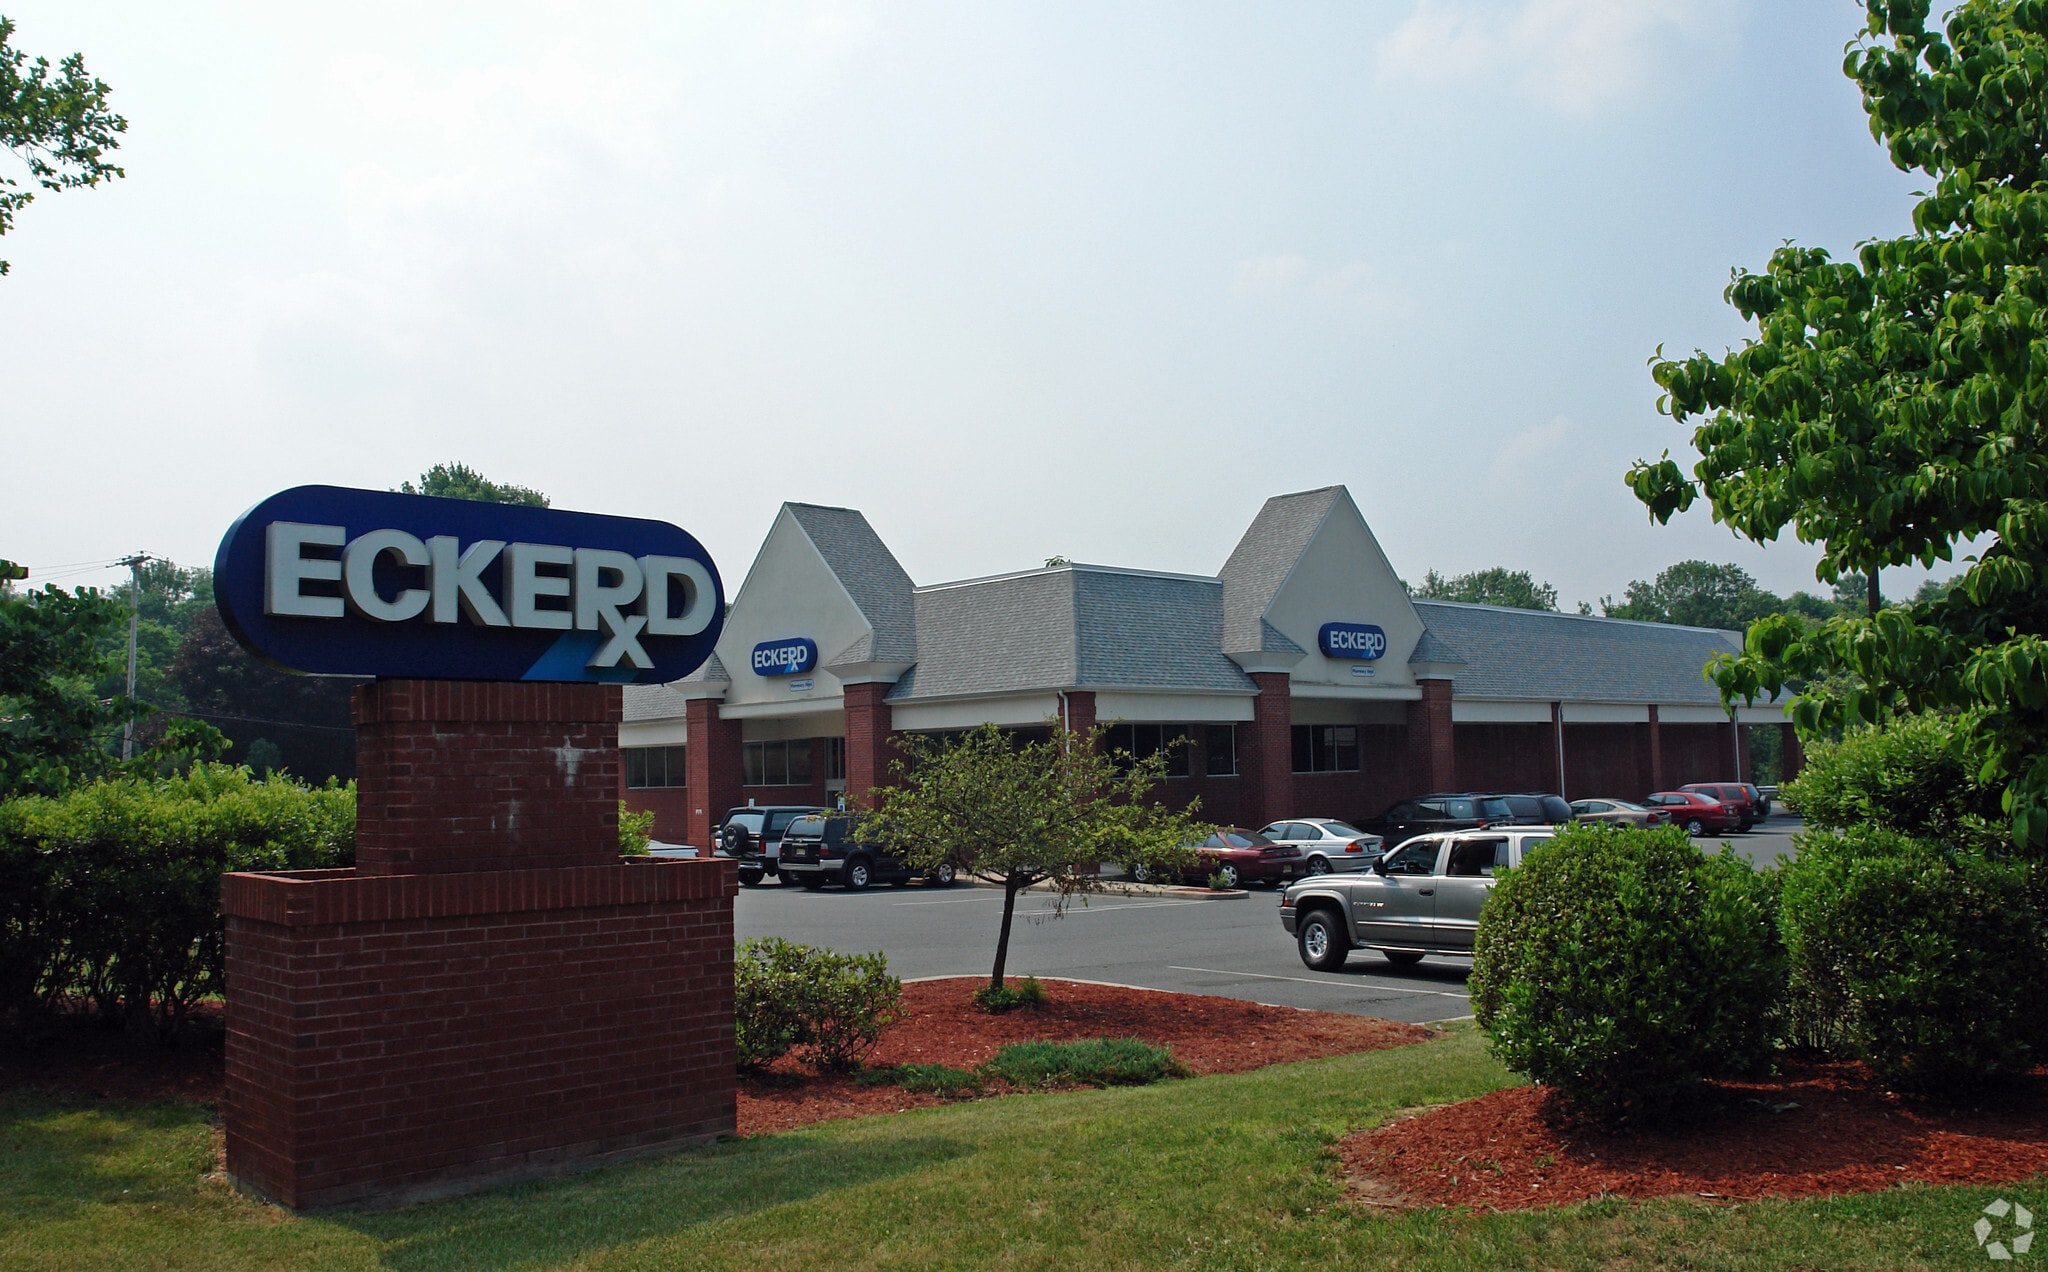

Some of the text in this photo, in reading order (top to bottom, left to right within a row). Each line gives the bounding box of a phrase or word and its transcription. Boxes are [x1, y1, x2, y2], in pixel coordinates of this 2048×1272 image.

[264, 520, 717, 636] ECKERD
[1330, 630, 1385, 650] ECKERD
[754, 645, 808, 668] ECKERD
